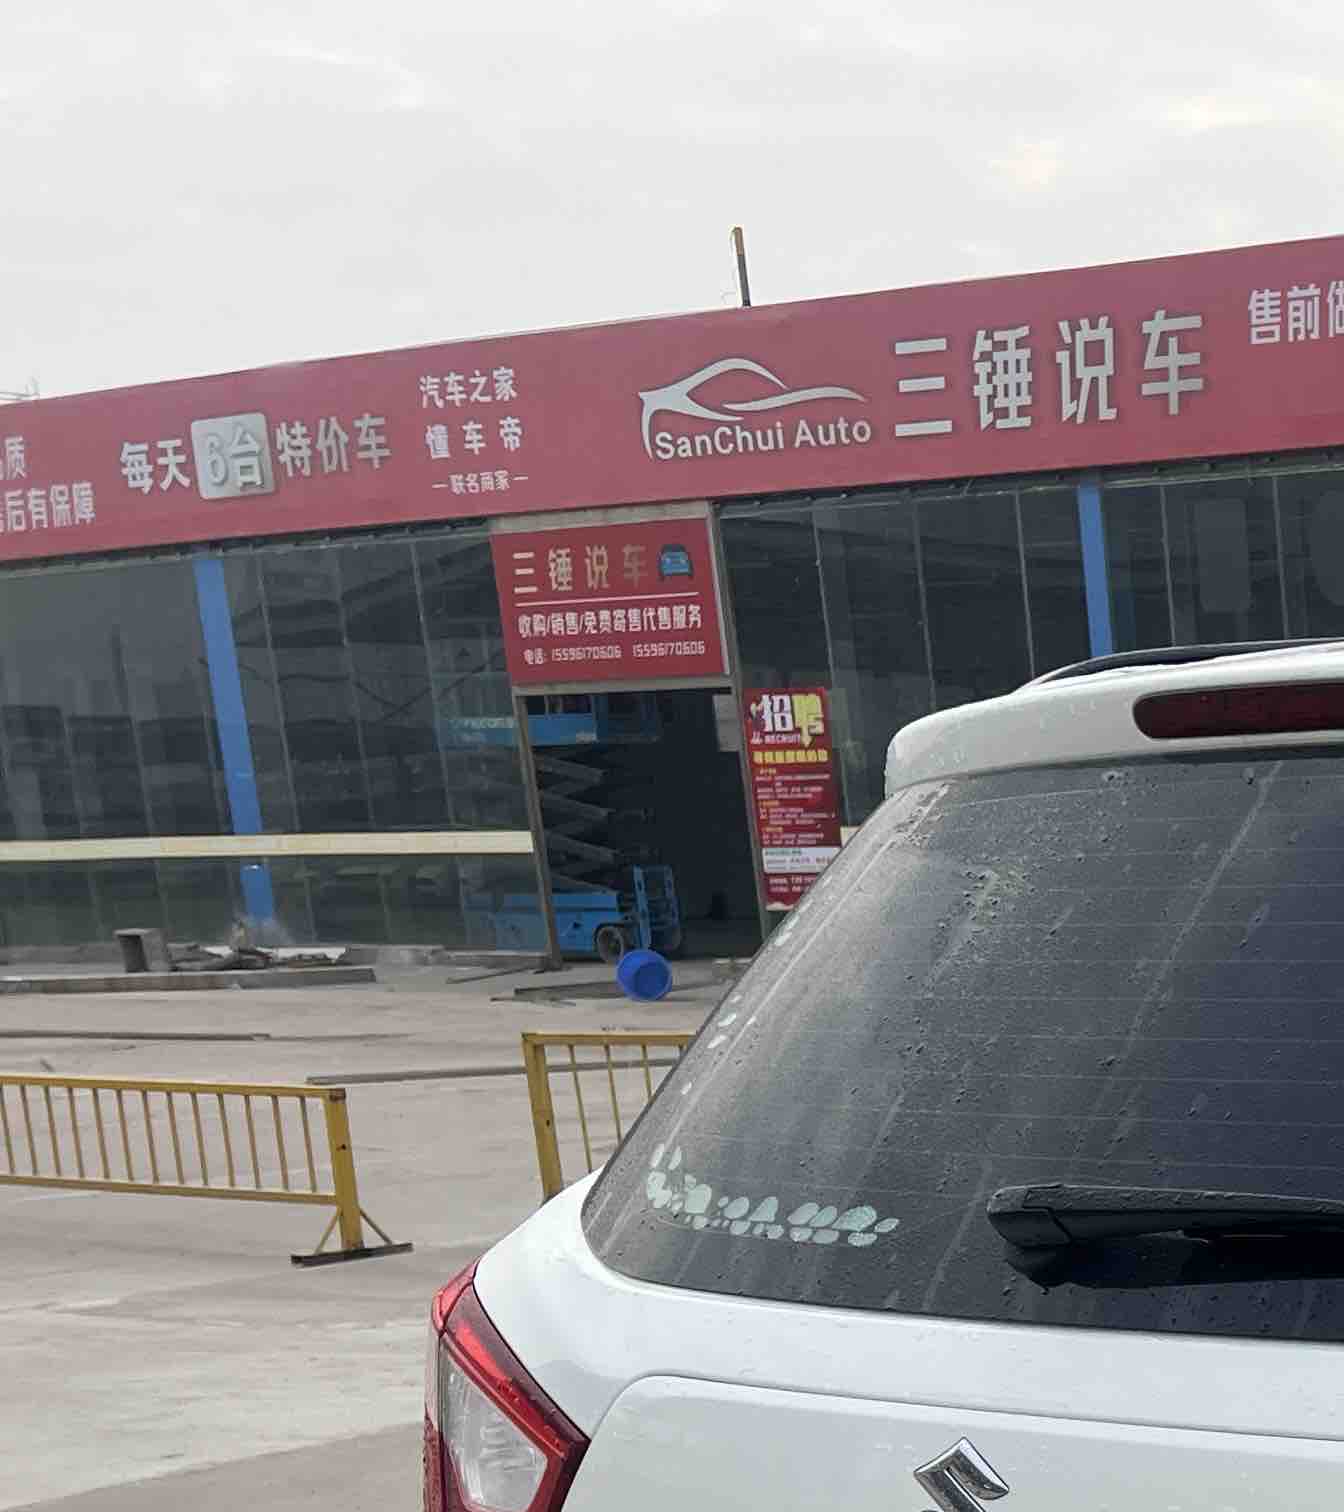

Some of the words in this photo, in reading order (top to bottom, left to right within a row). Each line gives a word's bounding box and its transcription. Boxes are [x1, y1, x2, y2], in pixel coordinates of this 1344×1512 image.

[419, 367, 518, 409] 汽车之家
[894, 309, 1206, 438] 三锤说车
[0, 436, 27, 480] 质
[425, 416, 523, 459] 懂车帝
[655, 423, 784, 462] SanChui
[795, 418, 872, 448] Auto
[512, 544, 649, 593] 三锤说车
